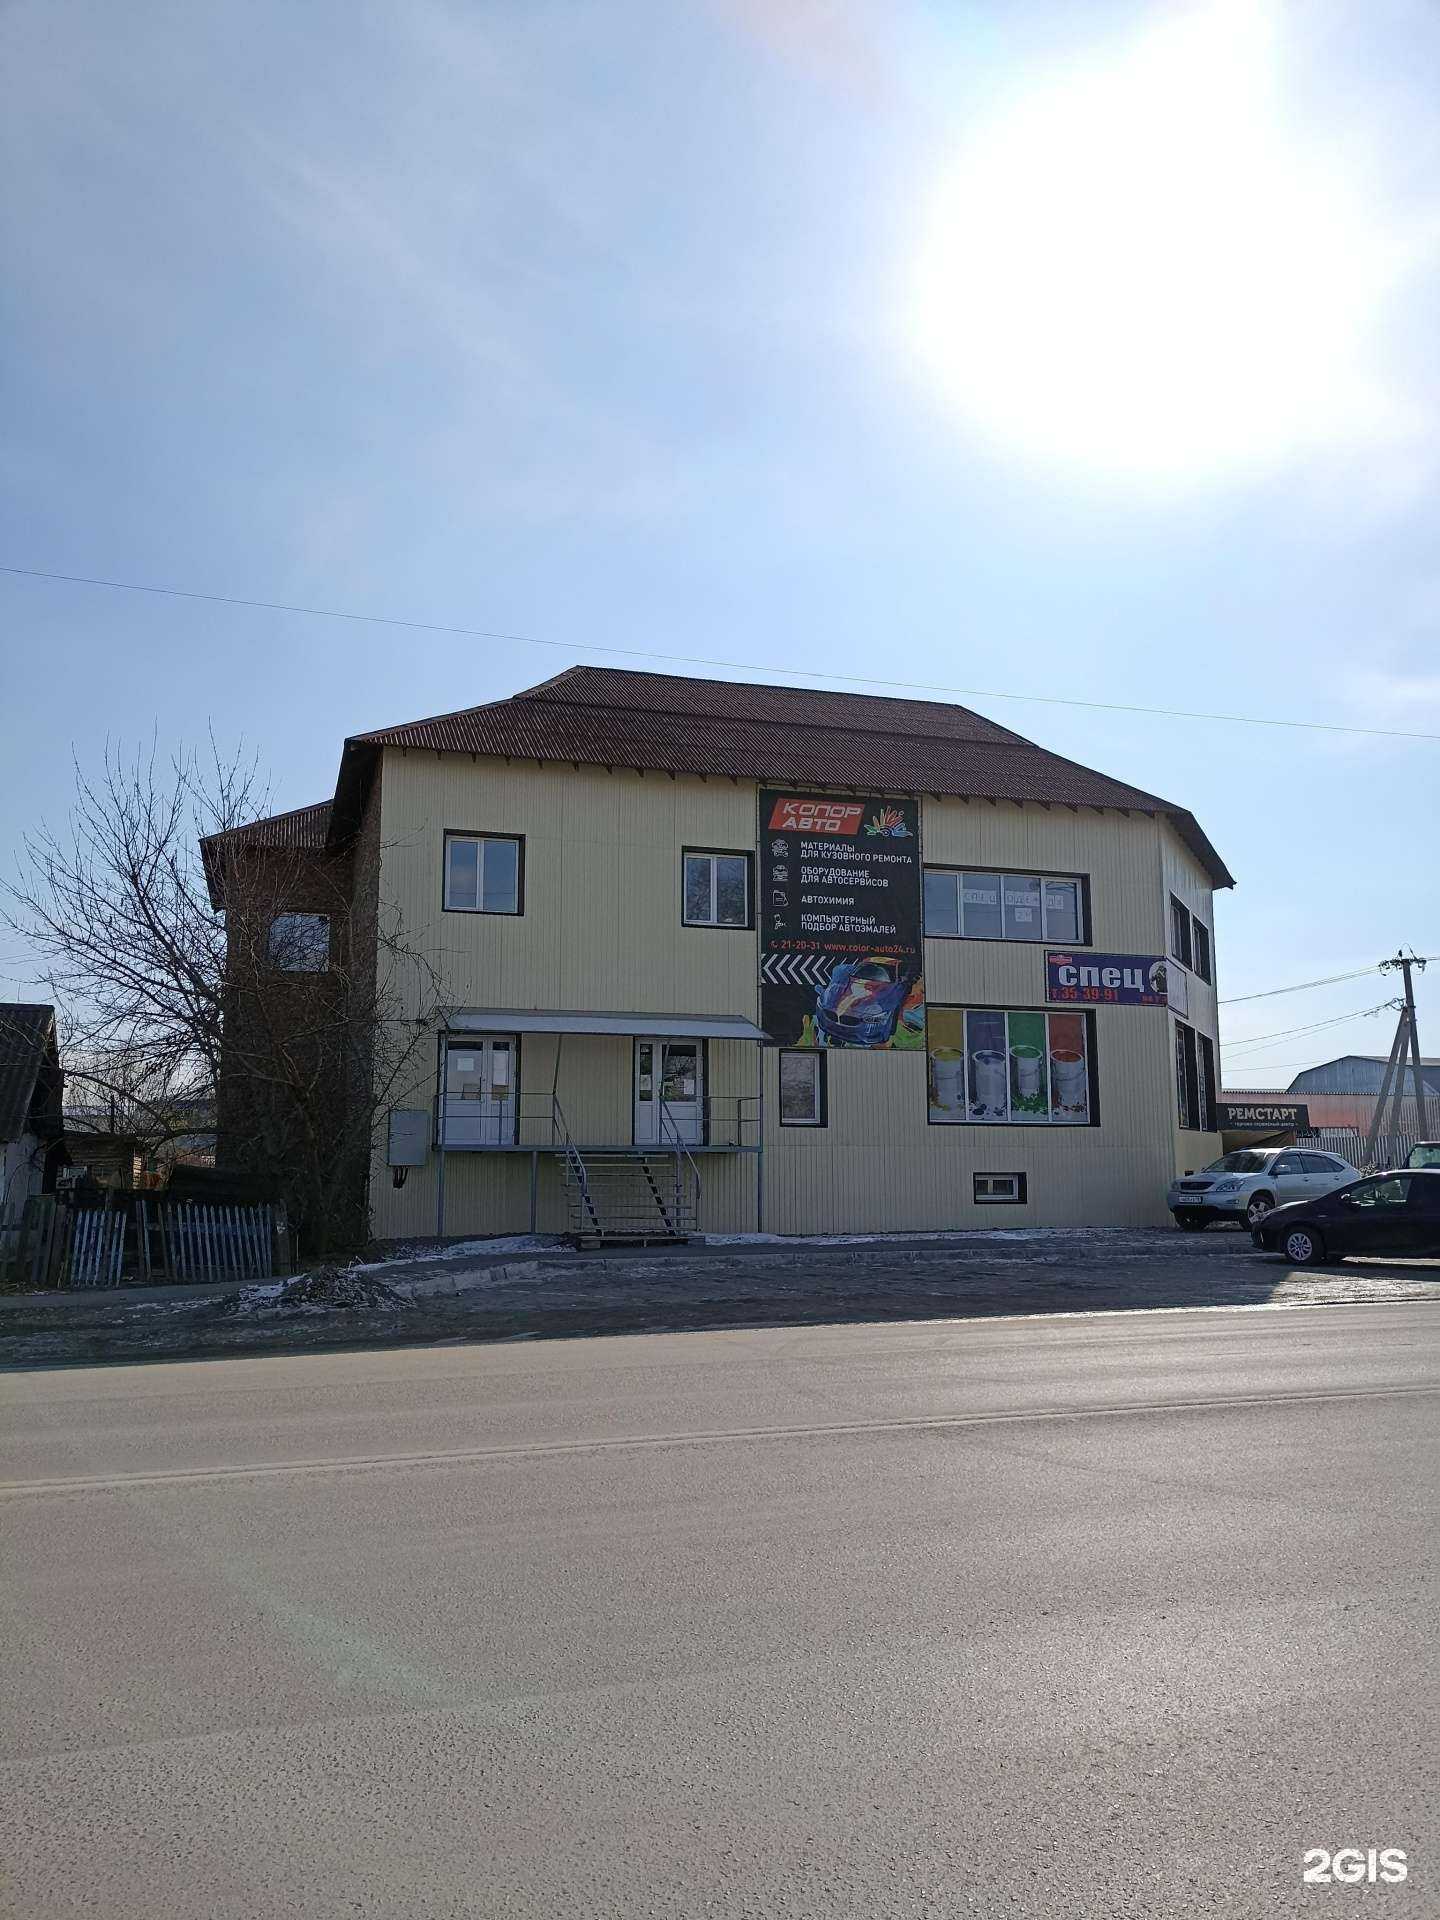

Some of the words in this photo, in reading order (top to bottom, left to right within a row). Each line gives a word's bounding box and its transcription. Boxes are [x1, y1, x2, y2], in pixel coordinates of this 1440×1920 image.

[781, 816, 842, 832] АВТО
[800, 841, 855, 853] МАТЕРИАЛЫ
[800, 850, 819, 859] ДЛЯ
[821, 851, 871, 862] КУЗОВНОГО
[872, 854, 912, 864] РЕМОНТА
[800, 866, 870, 878] ОБОРУДОВАНИЕ
[800, 875, 820, 884] ДЛЯ
[821, 876, 889, 888] АВТОСЕРВИСОВ
[800, 895, 855, 905] АВТОХИМИЯ
[800, 913, 876, 925] КОМПЬЮТЕРНЫЙ
[800, 922, 837, 932] ПОДБОР
[838, 923, 897, 934] АВТОЭМАЛЕЙ
[1227, 1107, 1297, 1120] РЕМСТАРТ
